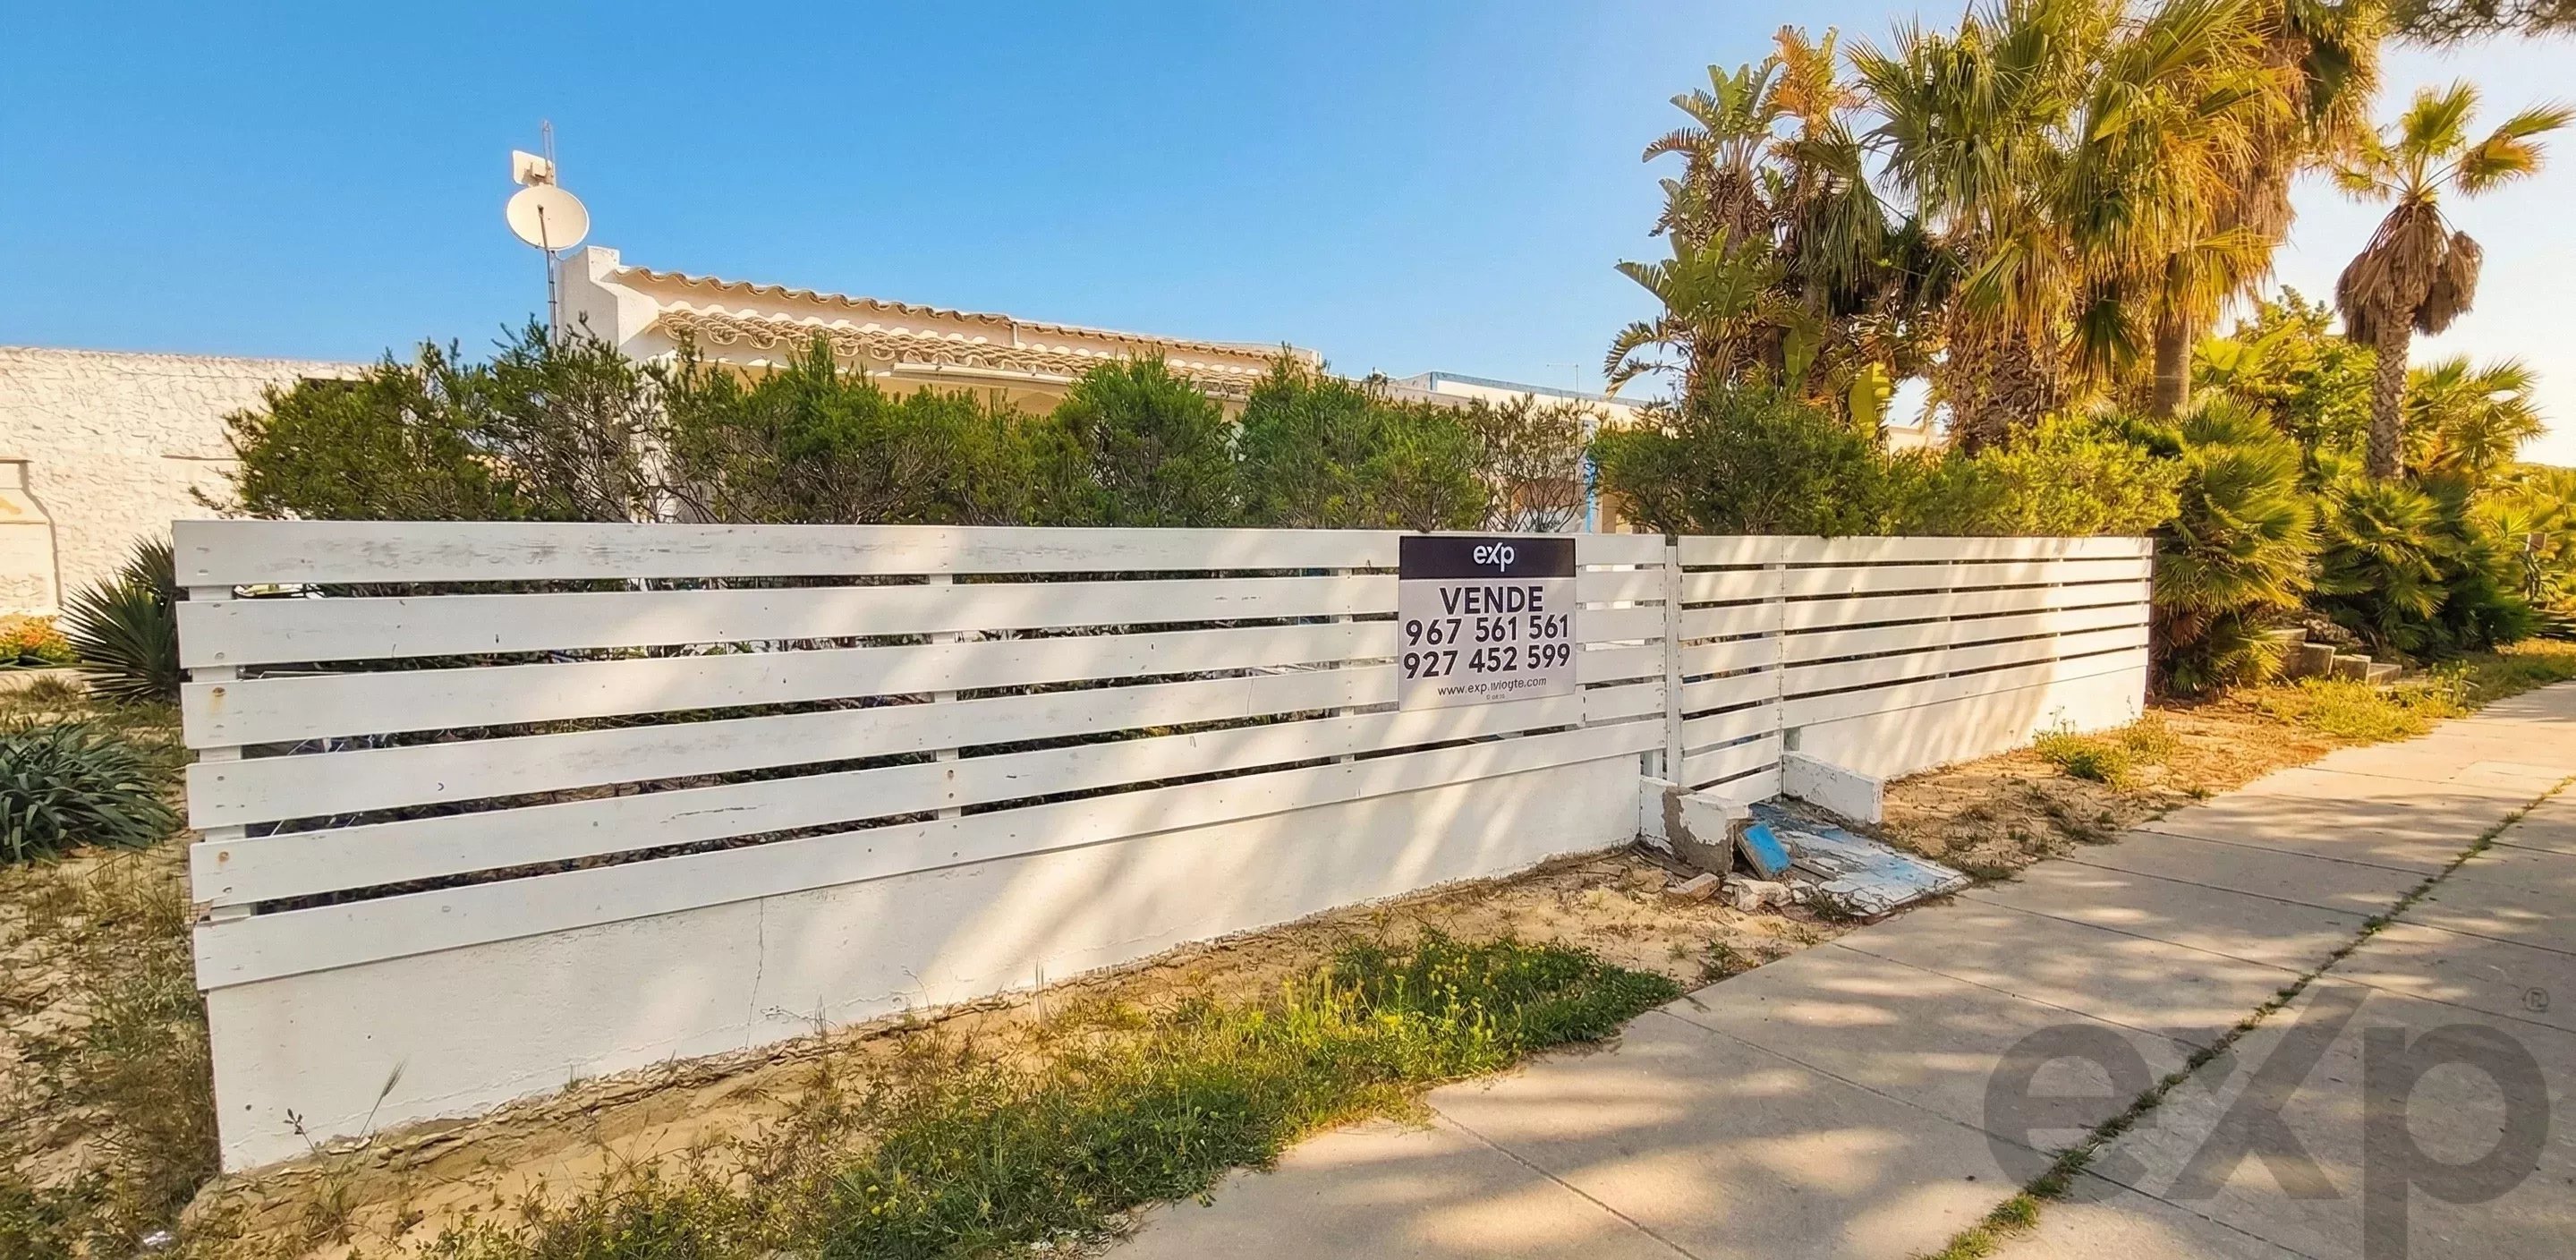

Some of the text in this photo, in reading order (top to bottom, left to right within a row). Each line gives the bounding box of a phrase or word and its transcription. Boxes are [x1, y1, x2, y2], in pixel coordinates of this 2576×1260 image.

[1473, 542, 1515, 572] exp
[1440, 586, 1543, 615] VENDE
[1405, 614, 1568, 646] 967 561 561
[1403, 643, 1570, 679] 927 452 599
